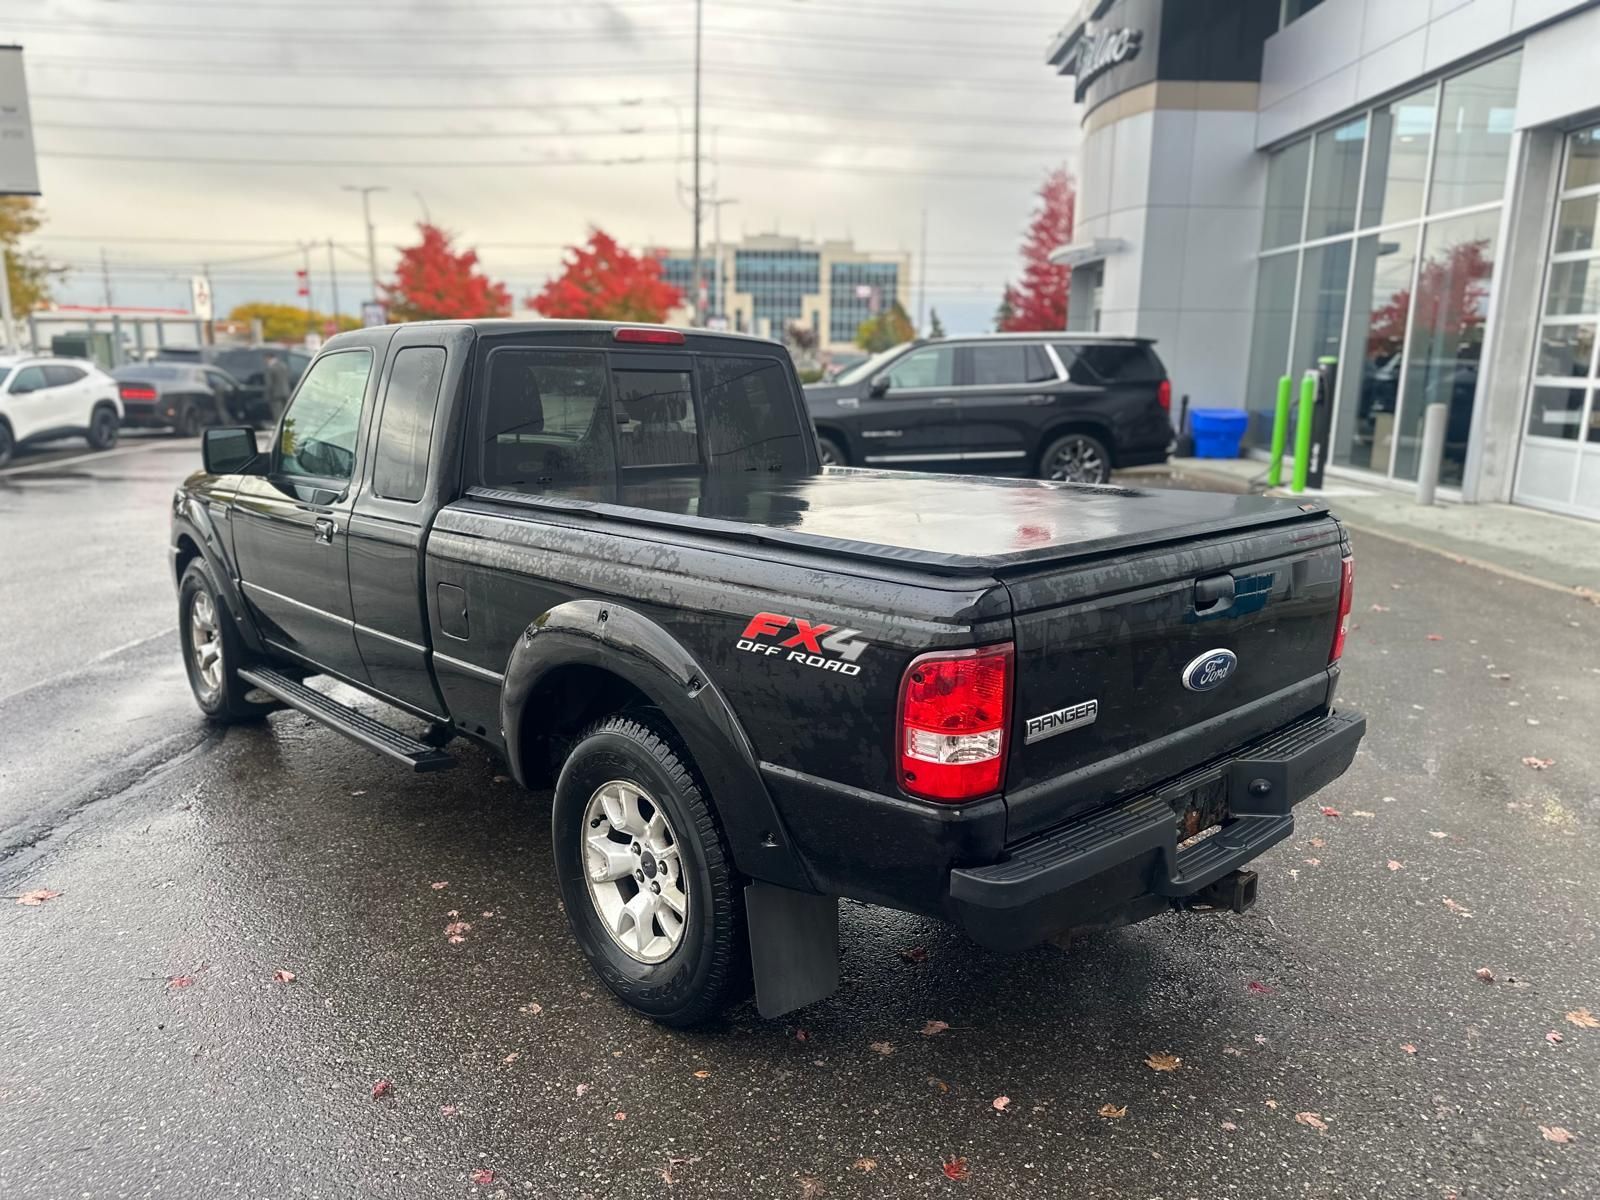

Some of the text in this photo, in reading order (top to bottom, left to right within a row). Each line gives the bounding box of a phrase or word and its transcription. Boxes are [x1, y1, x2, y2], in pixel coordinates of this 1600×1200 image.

[741, 611, 869, 662] FX4
[736, 639, 861, 676] OFF ROAD
[1200, 656, 1231, 685] Ford
[1029, 702, 1097, 735] RANGER
